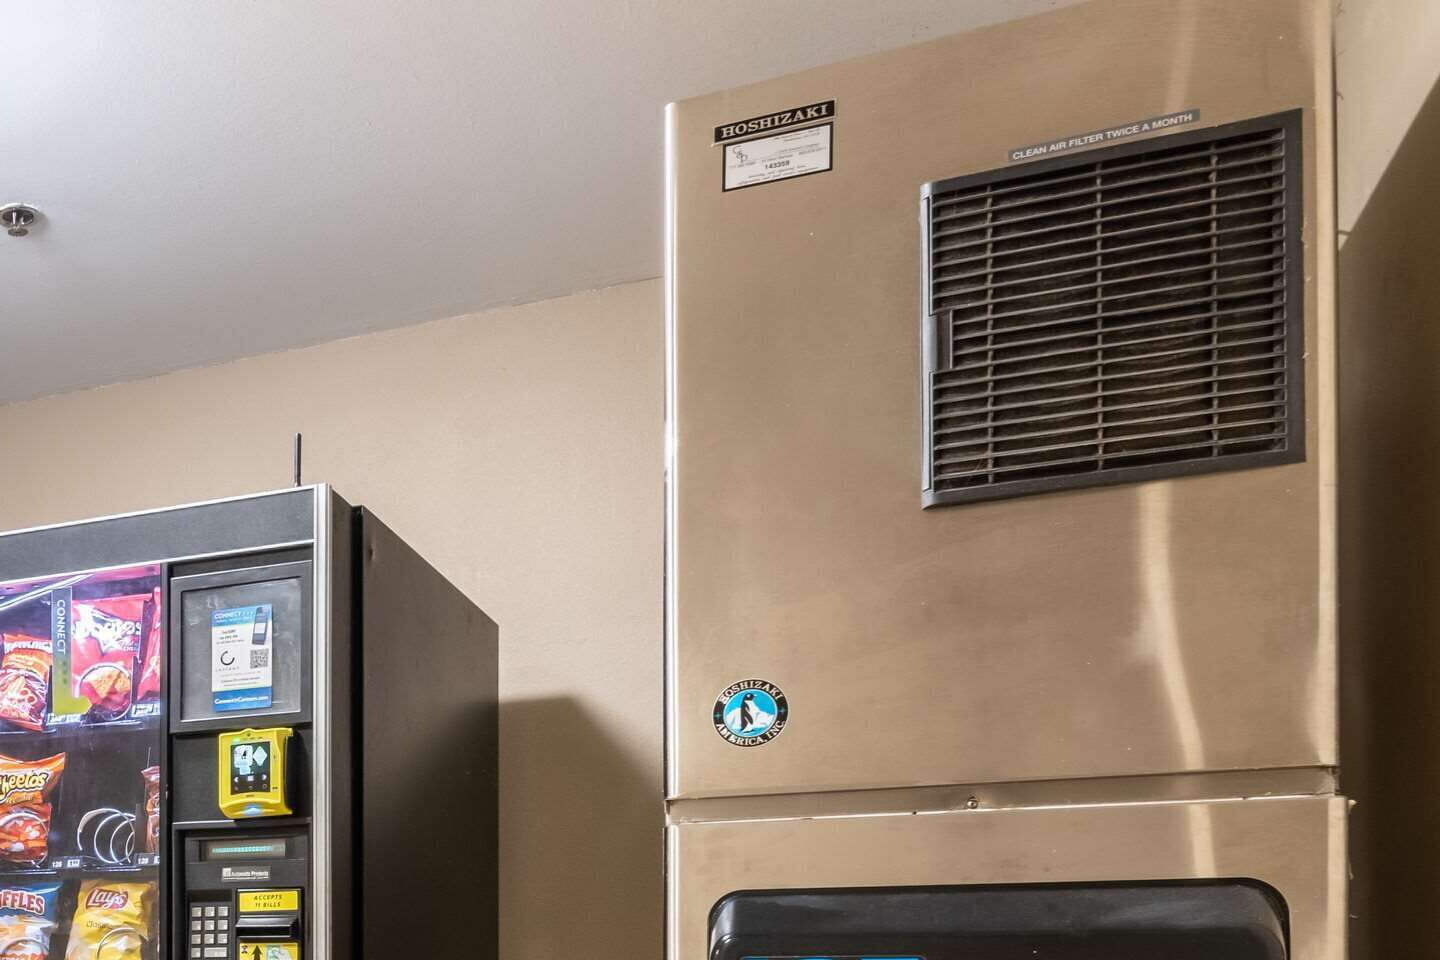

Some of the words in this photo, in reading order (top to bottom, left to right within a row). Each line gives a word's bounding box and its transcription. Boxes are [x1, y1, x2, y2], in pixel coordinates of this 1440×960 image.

[720, 104, 829, 139] HOSHIZAKI
[1012, 146, 1046, 160] CLEAN
[1048, 141, 1067, 152] AIR
[1068, 133, 1104, 148] FILTER
[1106, 125, 1140, 139] TWICE
[1141, 123, 1150, 131] A
[1152, 113, 1192, 129] MONTH
[57, 600, 66, 655] CONNECT
[718, 680, 783, 705] HOSHIZAKI
[87, 888, 128, 910] Lay's
